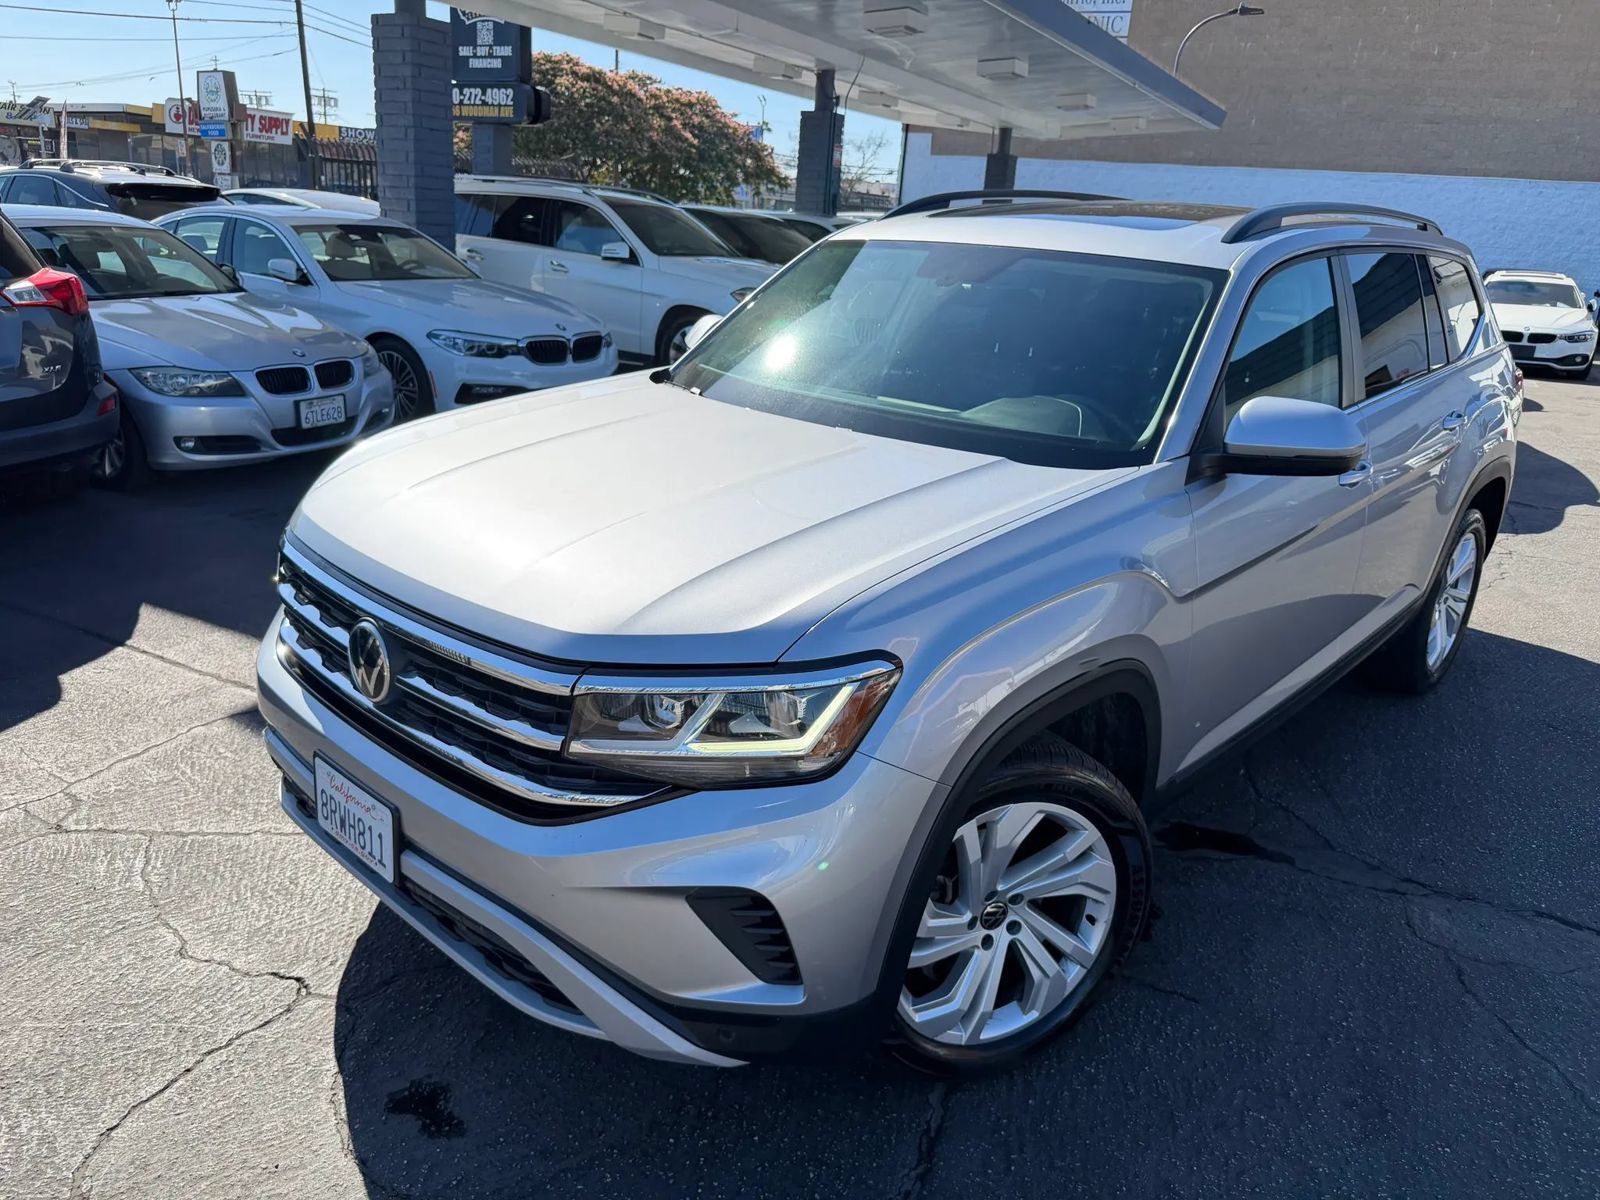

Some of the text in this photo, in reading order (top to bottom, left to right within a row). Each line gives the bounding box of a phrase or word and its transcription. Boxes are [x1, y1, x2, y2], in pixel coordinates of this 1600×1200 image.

[458, 46, 513, 56] SALE BUY TRADE
[469, 58, 502, 68] FINANCING
[461, 106, 498, 117] WOODMAN
[500, 107, 514, 117] AVE
[259, 115, 291, 136] SUPPLY
[305, 407, 343, 425] 6TLE628
[329, 775, 376, 821] California
[320, 788, 387, 868] 8RWH811
